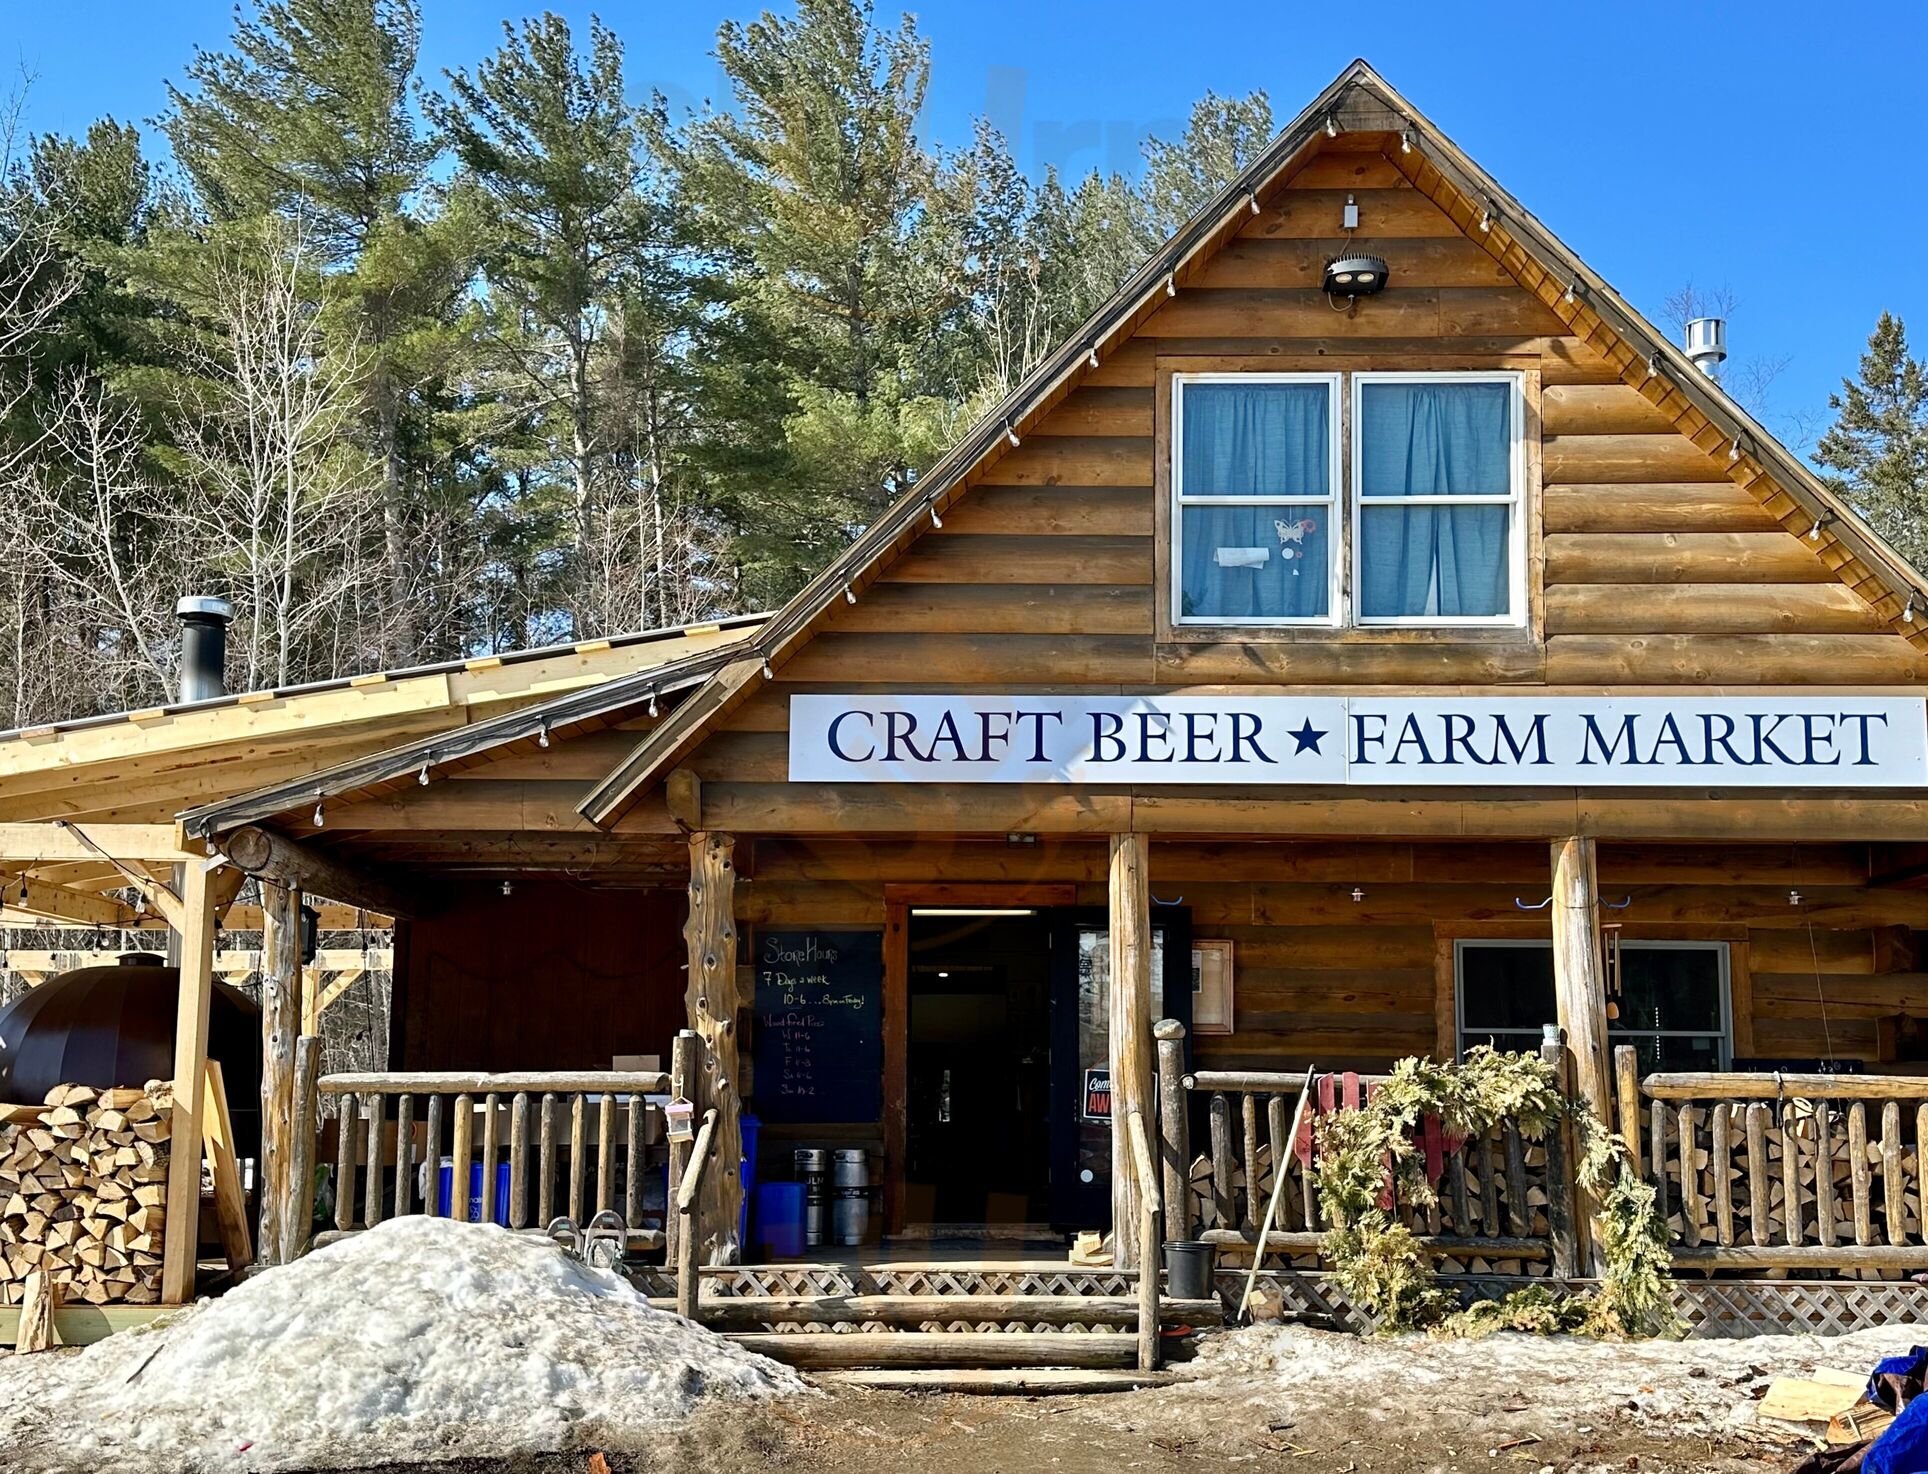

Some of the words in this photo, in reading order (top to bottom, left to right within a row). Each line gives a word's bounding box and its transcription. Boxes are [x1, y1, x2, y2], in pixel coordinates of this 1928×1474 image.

[827, 709, 1063, 763] CRAFT
[1085, 711, 1279, 764] BEER
[1349, 711, 1555, 766] FARM
[1576, 711, 1888, 766] MARKET
[763, 971, 772, 987] 7
[807, 975, 831, 986] week
[1089, 1077, 1111, 1092] Com
[1088, 1093, 1112, 1114] AW
